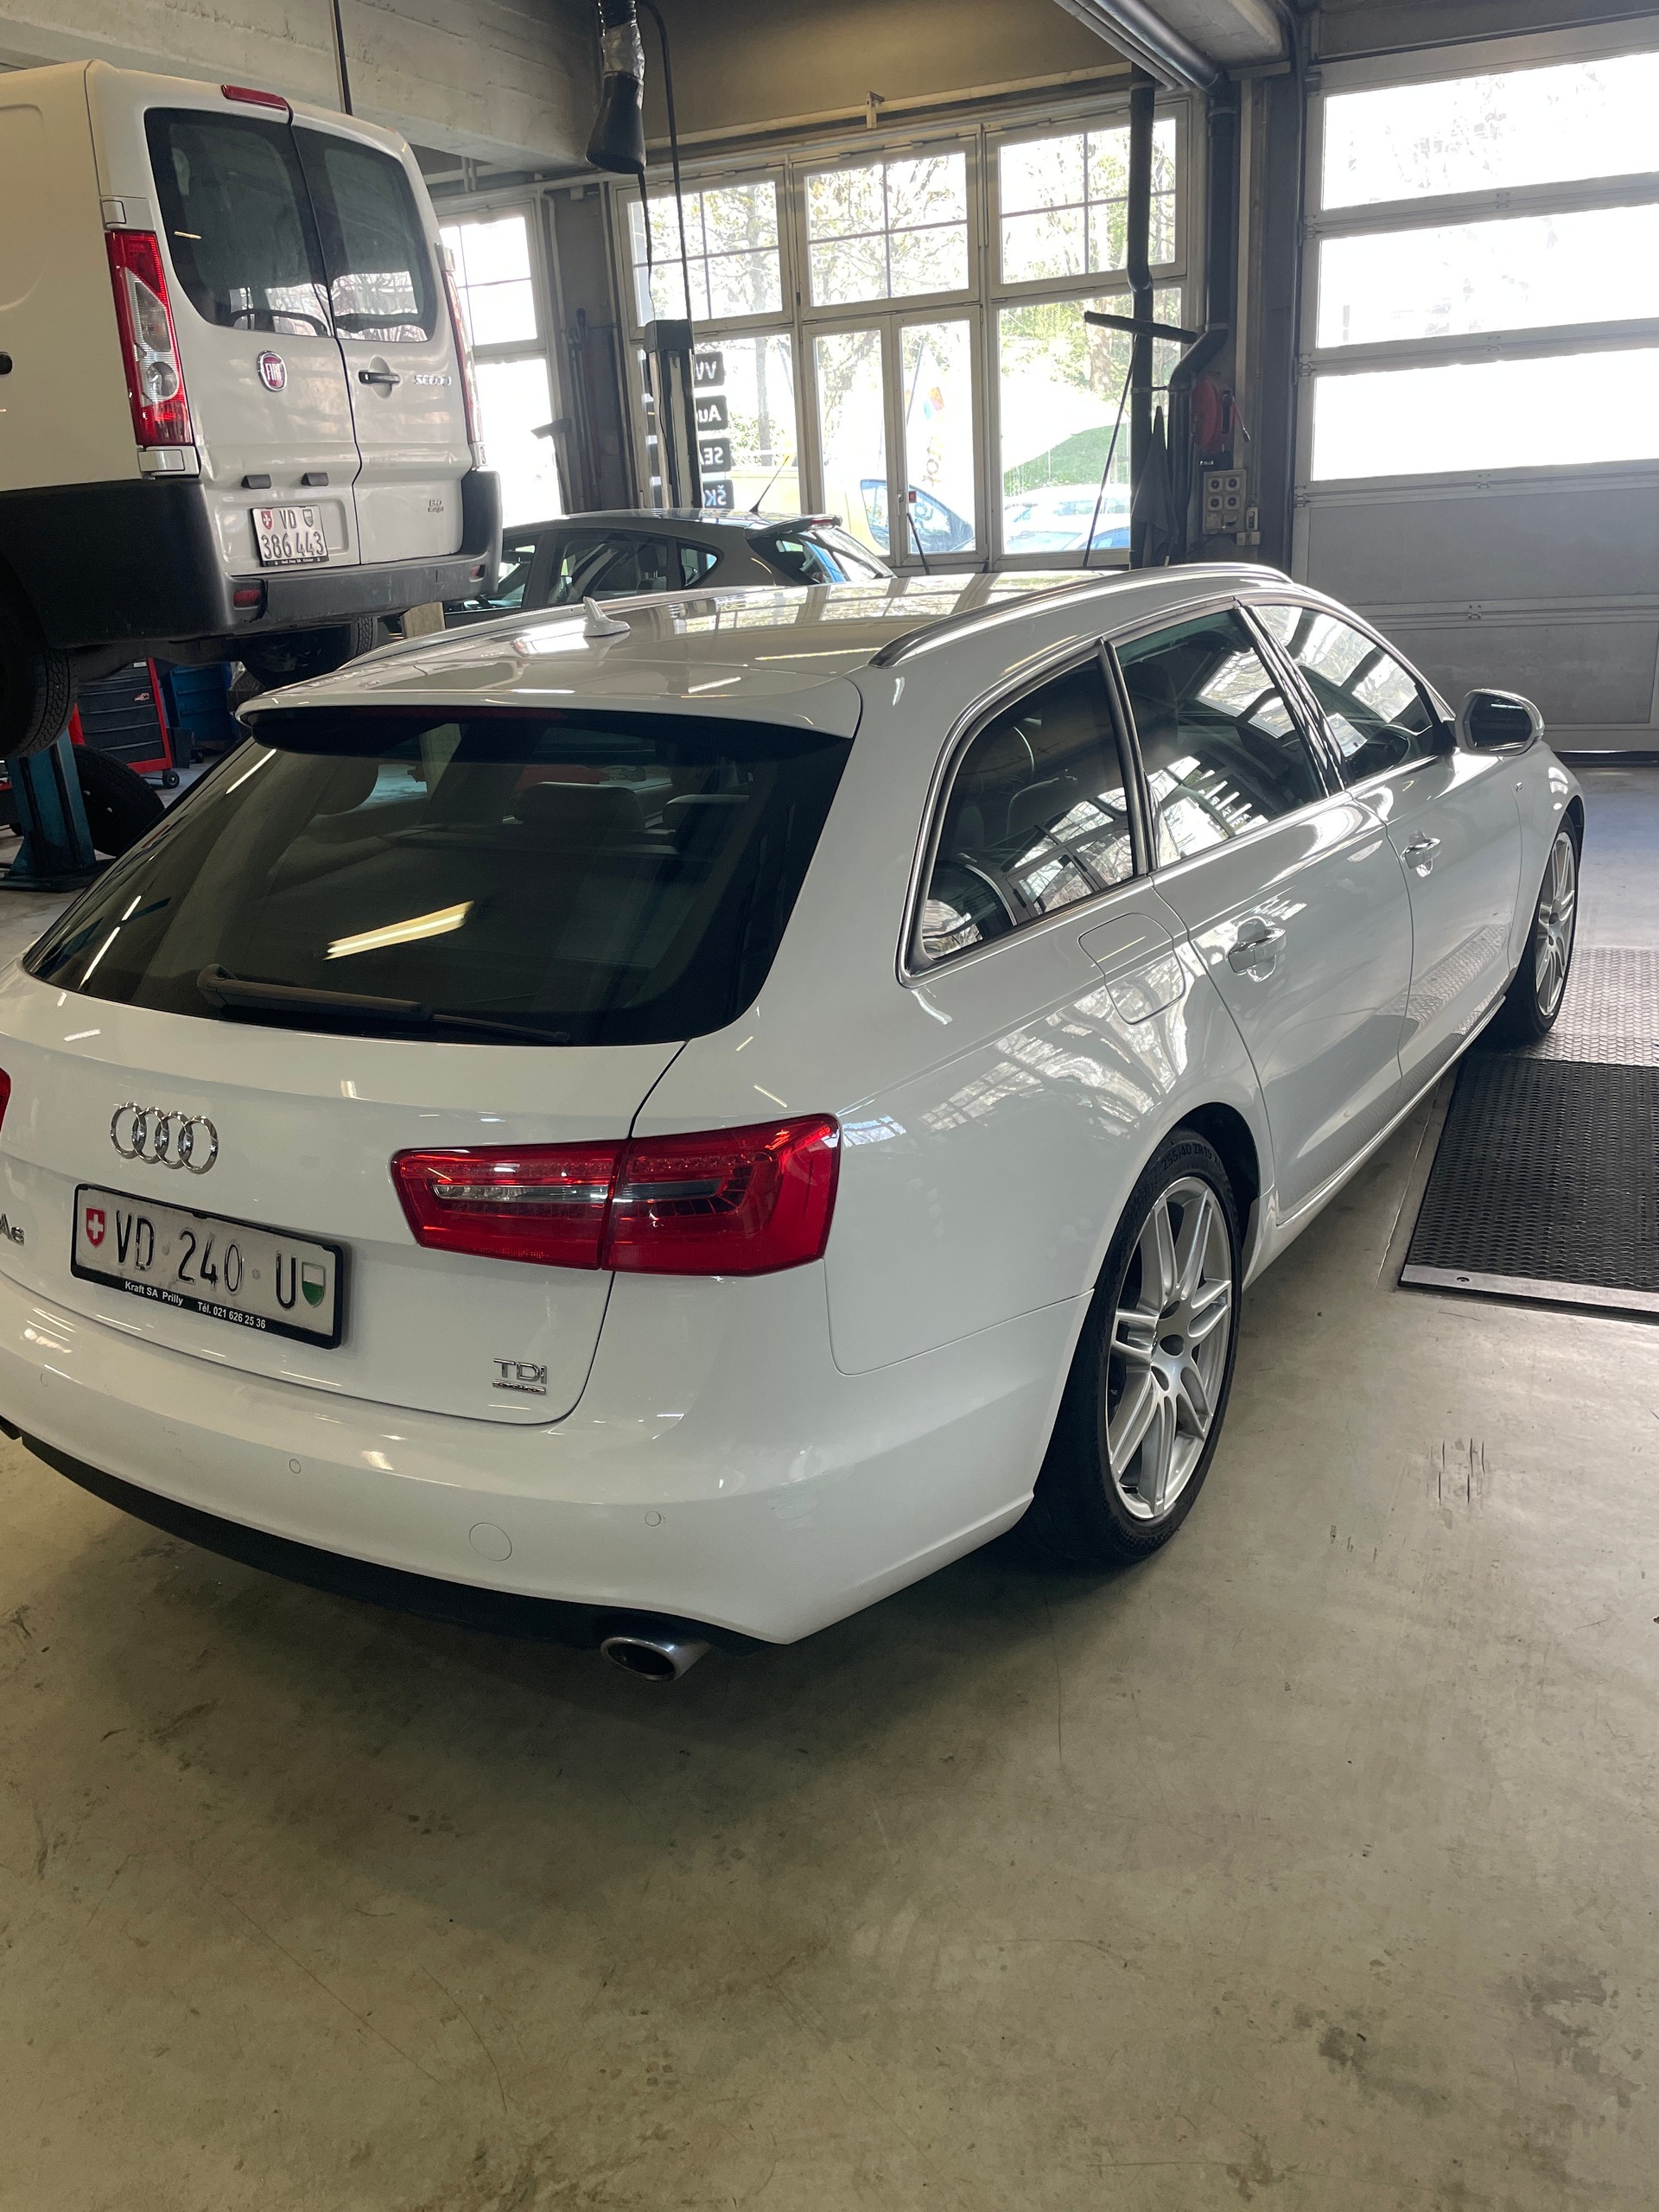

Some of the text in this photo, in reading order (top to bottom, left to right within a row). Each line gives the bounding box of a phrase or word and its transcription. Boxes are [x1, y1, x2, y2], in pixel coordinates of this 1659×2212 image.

[264, 363, 283, 381] FIAT
[279, 510, 296, 529] VD
[261, 531, 324, 559] 386 443
[1161, 1144, 1192, 1172] 255/40
[0, 1213, 25, 1247] A6
[116, 1209, 298, 1310] VD 240 U
[124, 1281, 266, 1329] Kraft SA Prilly Tél. 021 626 25 36
[493, 1357, 548, 1385] TDI
